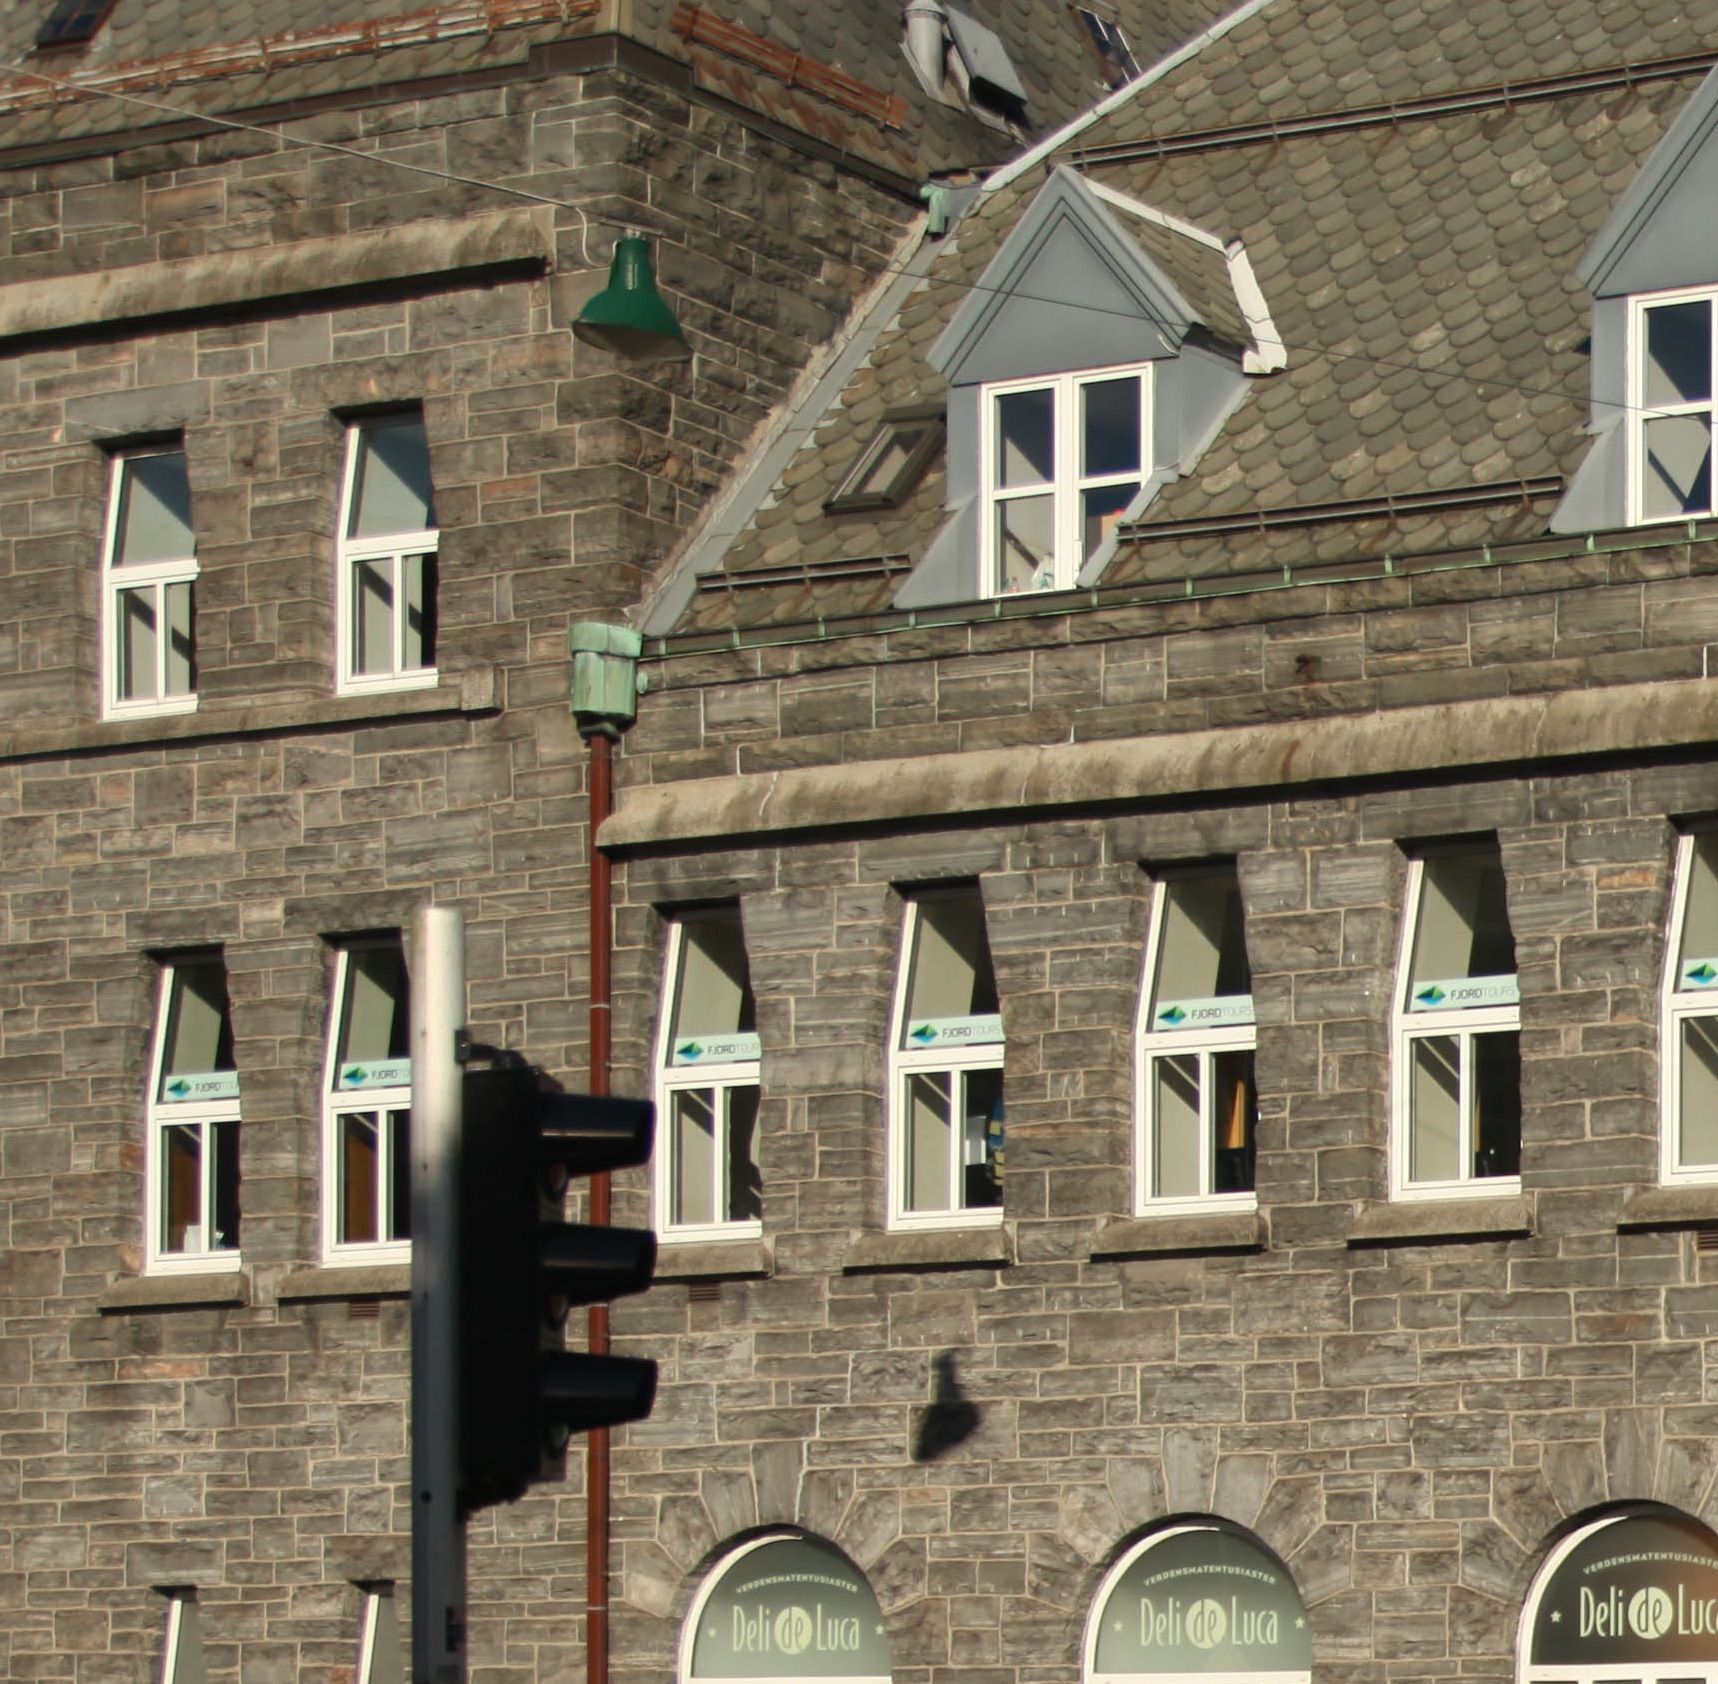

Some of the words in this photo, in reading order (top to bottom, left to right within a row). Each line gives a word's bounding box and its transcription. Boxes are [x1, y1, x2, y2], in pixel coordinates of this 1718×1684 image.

[1144, 1564, 1276, 1587] VERDENSMATENTUSIASTER
[733, 1604, 770, 1651] Deli
[781, 1606, 806, 1653] de
[816, 1603, 860, 1651] Luca
[1140, 1597, 1181, 1646] Deli
[1192, 1599, 1218, 1648] de
[1231, 1595, 1279, 1645] Luca
[1580, 1585, 1624, 1637] Deli
[1635, 1586, 1664, 1639] de
